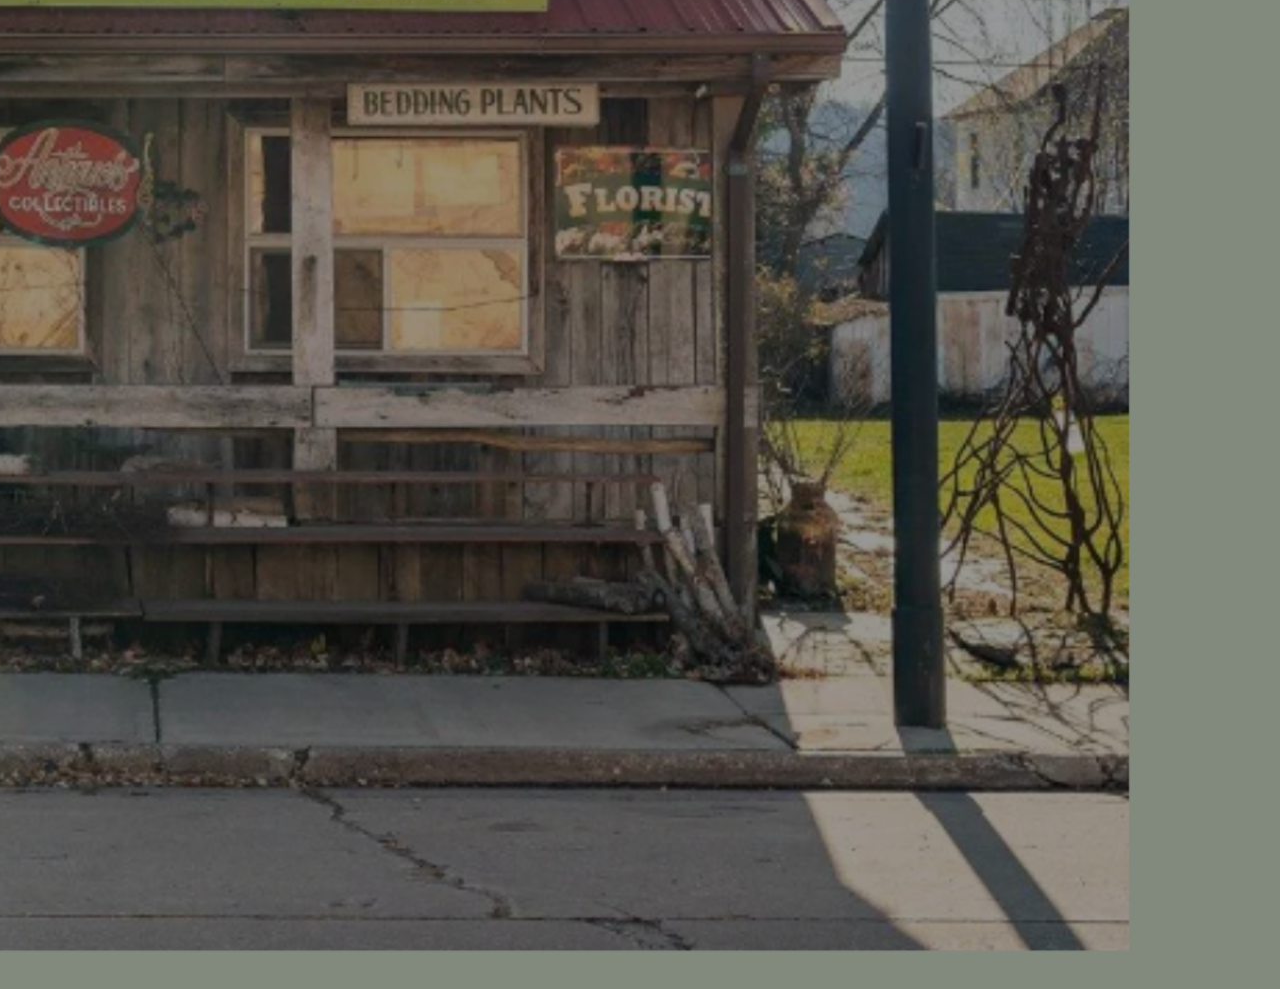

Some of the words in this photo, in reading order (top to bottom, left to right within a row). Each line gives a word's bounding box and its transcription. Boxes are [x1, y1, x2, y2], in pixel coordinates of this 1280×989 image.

[363, 89, 471, 116] BEDDING
[480, 88, 582, 115] PLANTS
[8, 194, 127, 214] COLLECTIBLES
